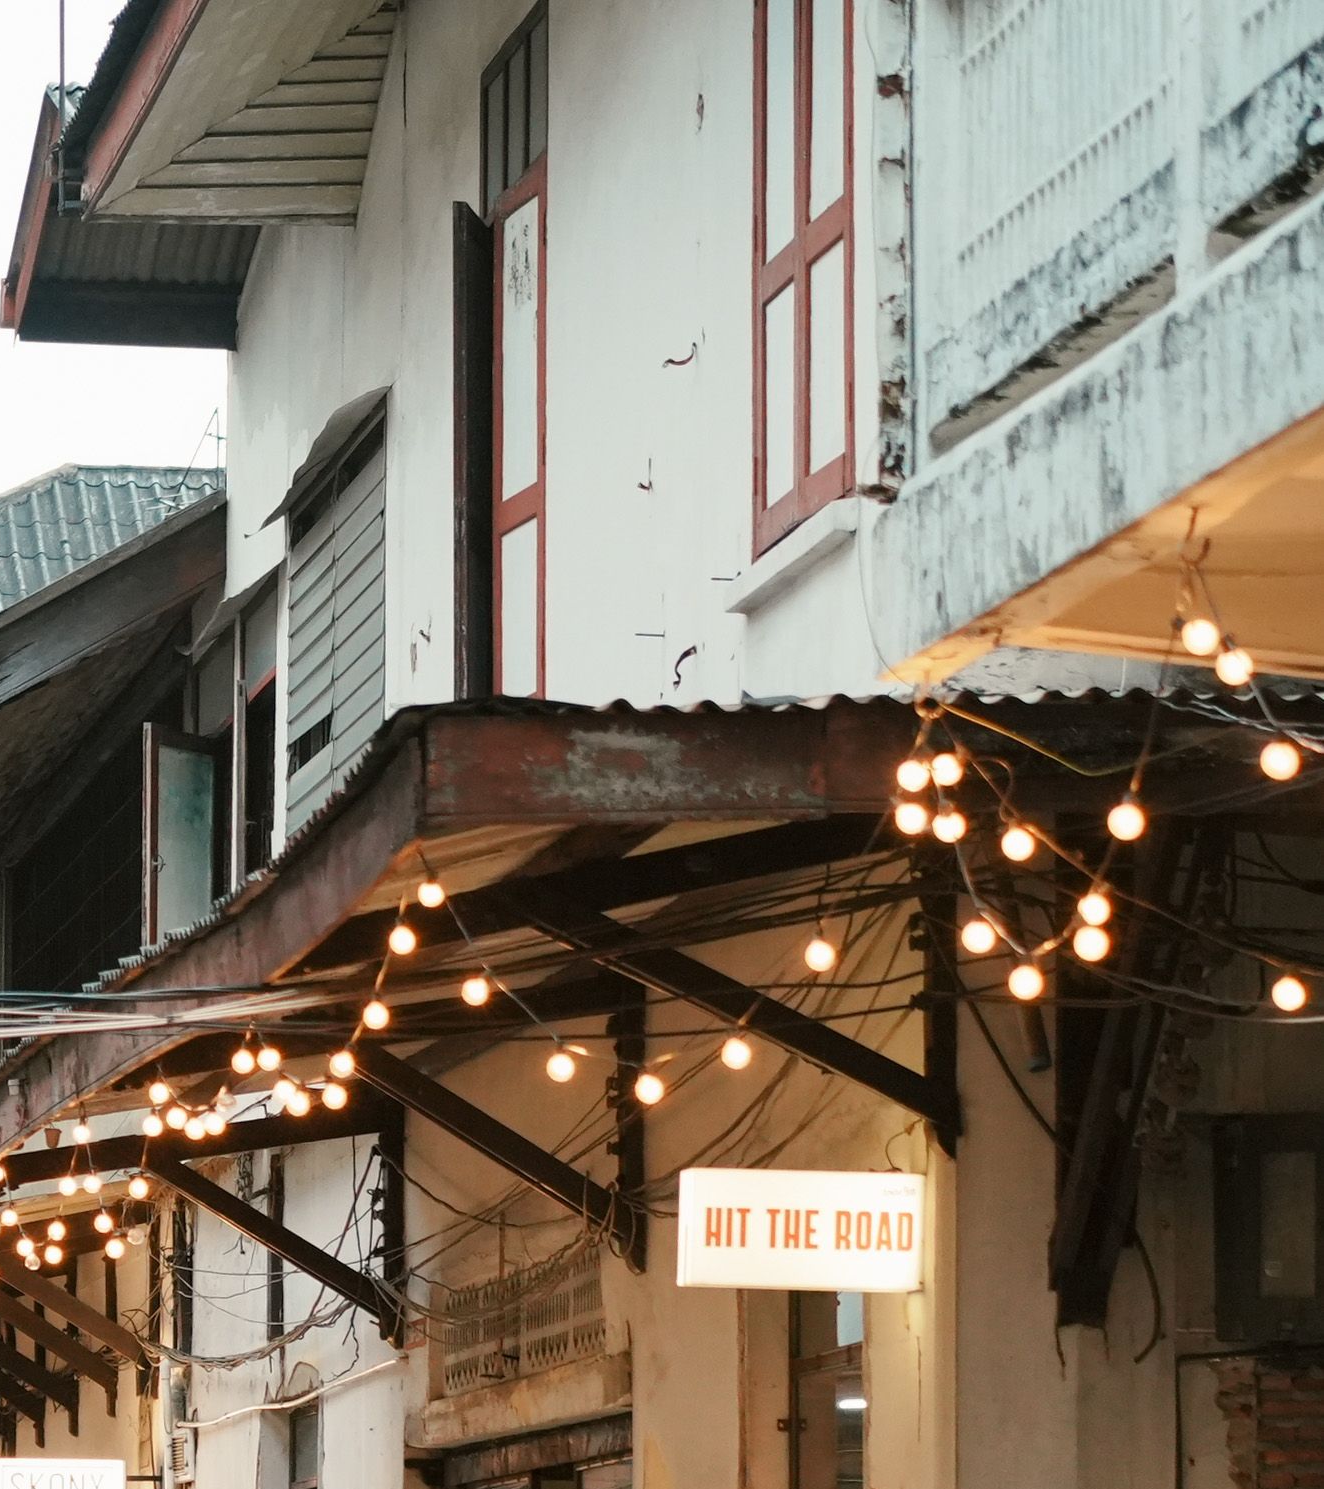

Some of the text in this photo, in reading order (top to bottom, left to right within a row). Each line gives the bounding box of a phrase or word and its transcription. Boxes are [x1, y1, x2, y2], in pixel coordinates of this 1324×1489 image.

[705, 1207, 914, 1251] HIT THE ROAD
